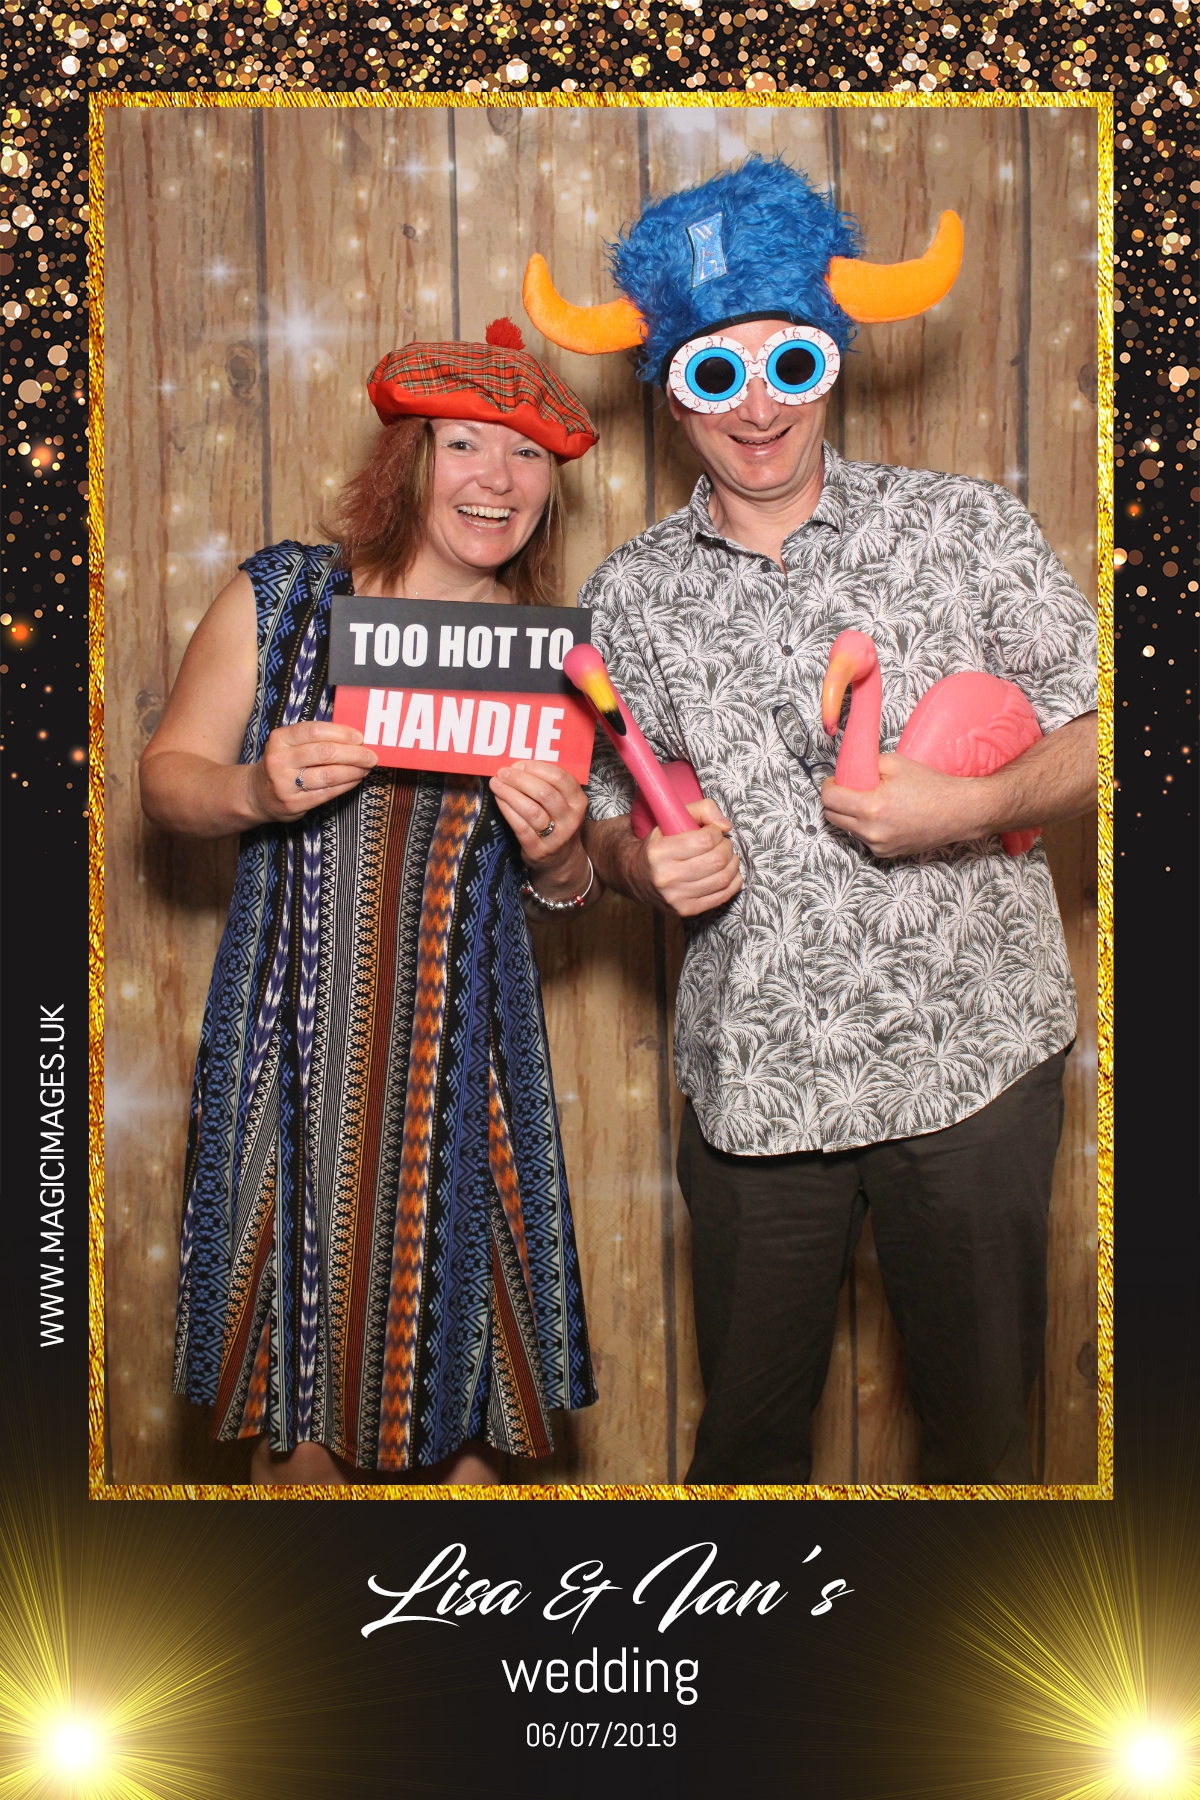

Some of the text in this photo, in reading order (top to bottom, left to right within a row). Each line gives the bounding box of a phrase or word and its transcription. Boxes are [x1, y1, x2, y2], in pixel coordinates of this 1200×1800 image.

[350, 622, 574, 670] TOO HOT TO
[363, 688, 565, 762] HANDLE
